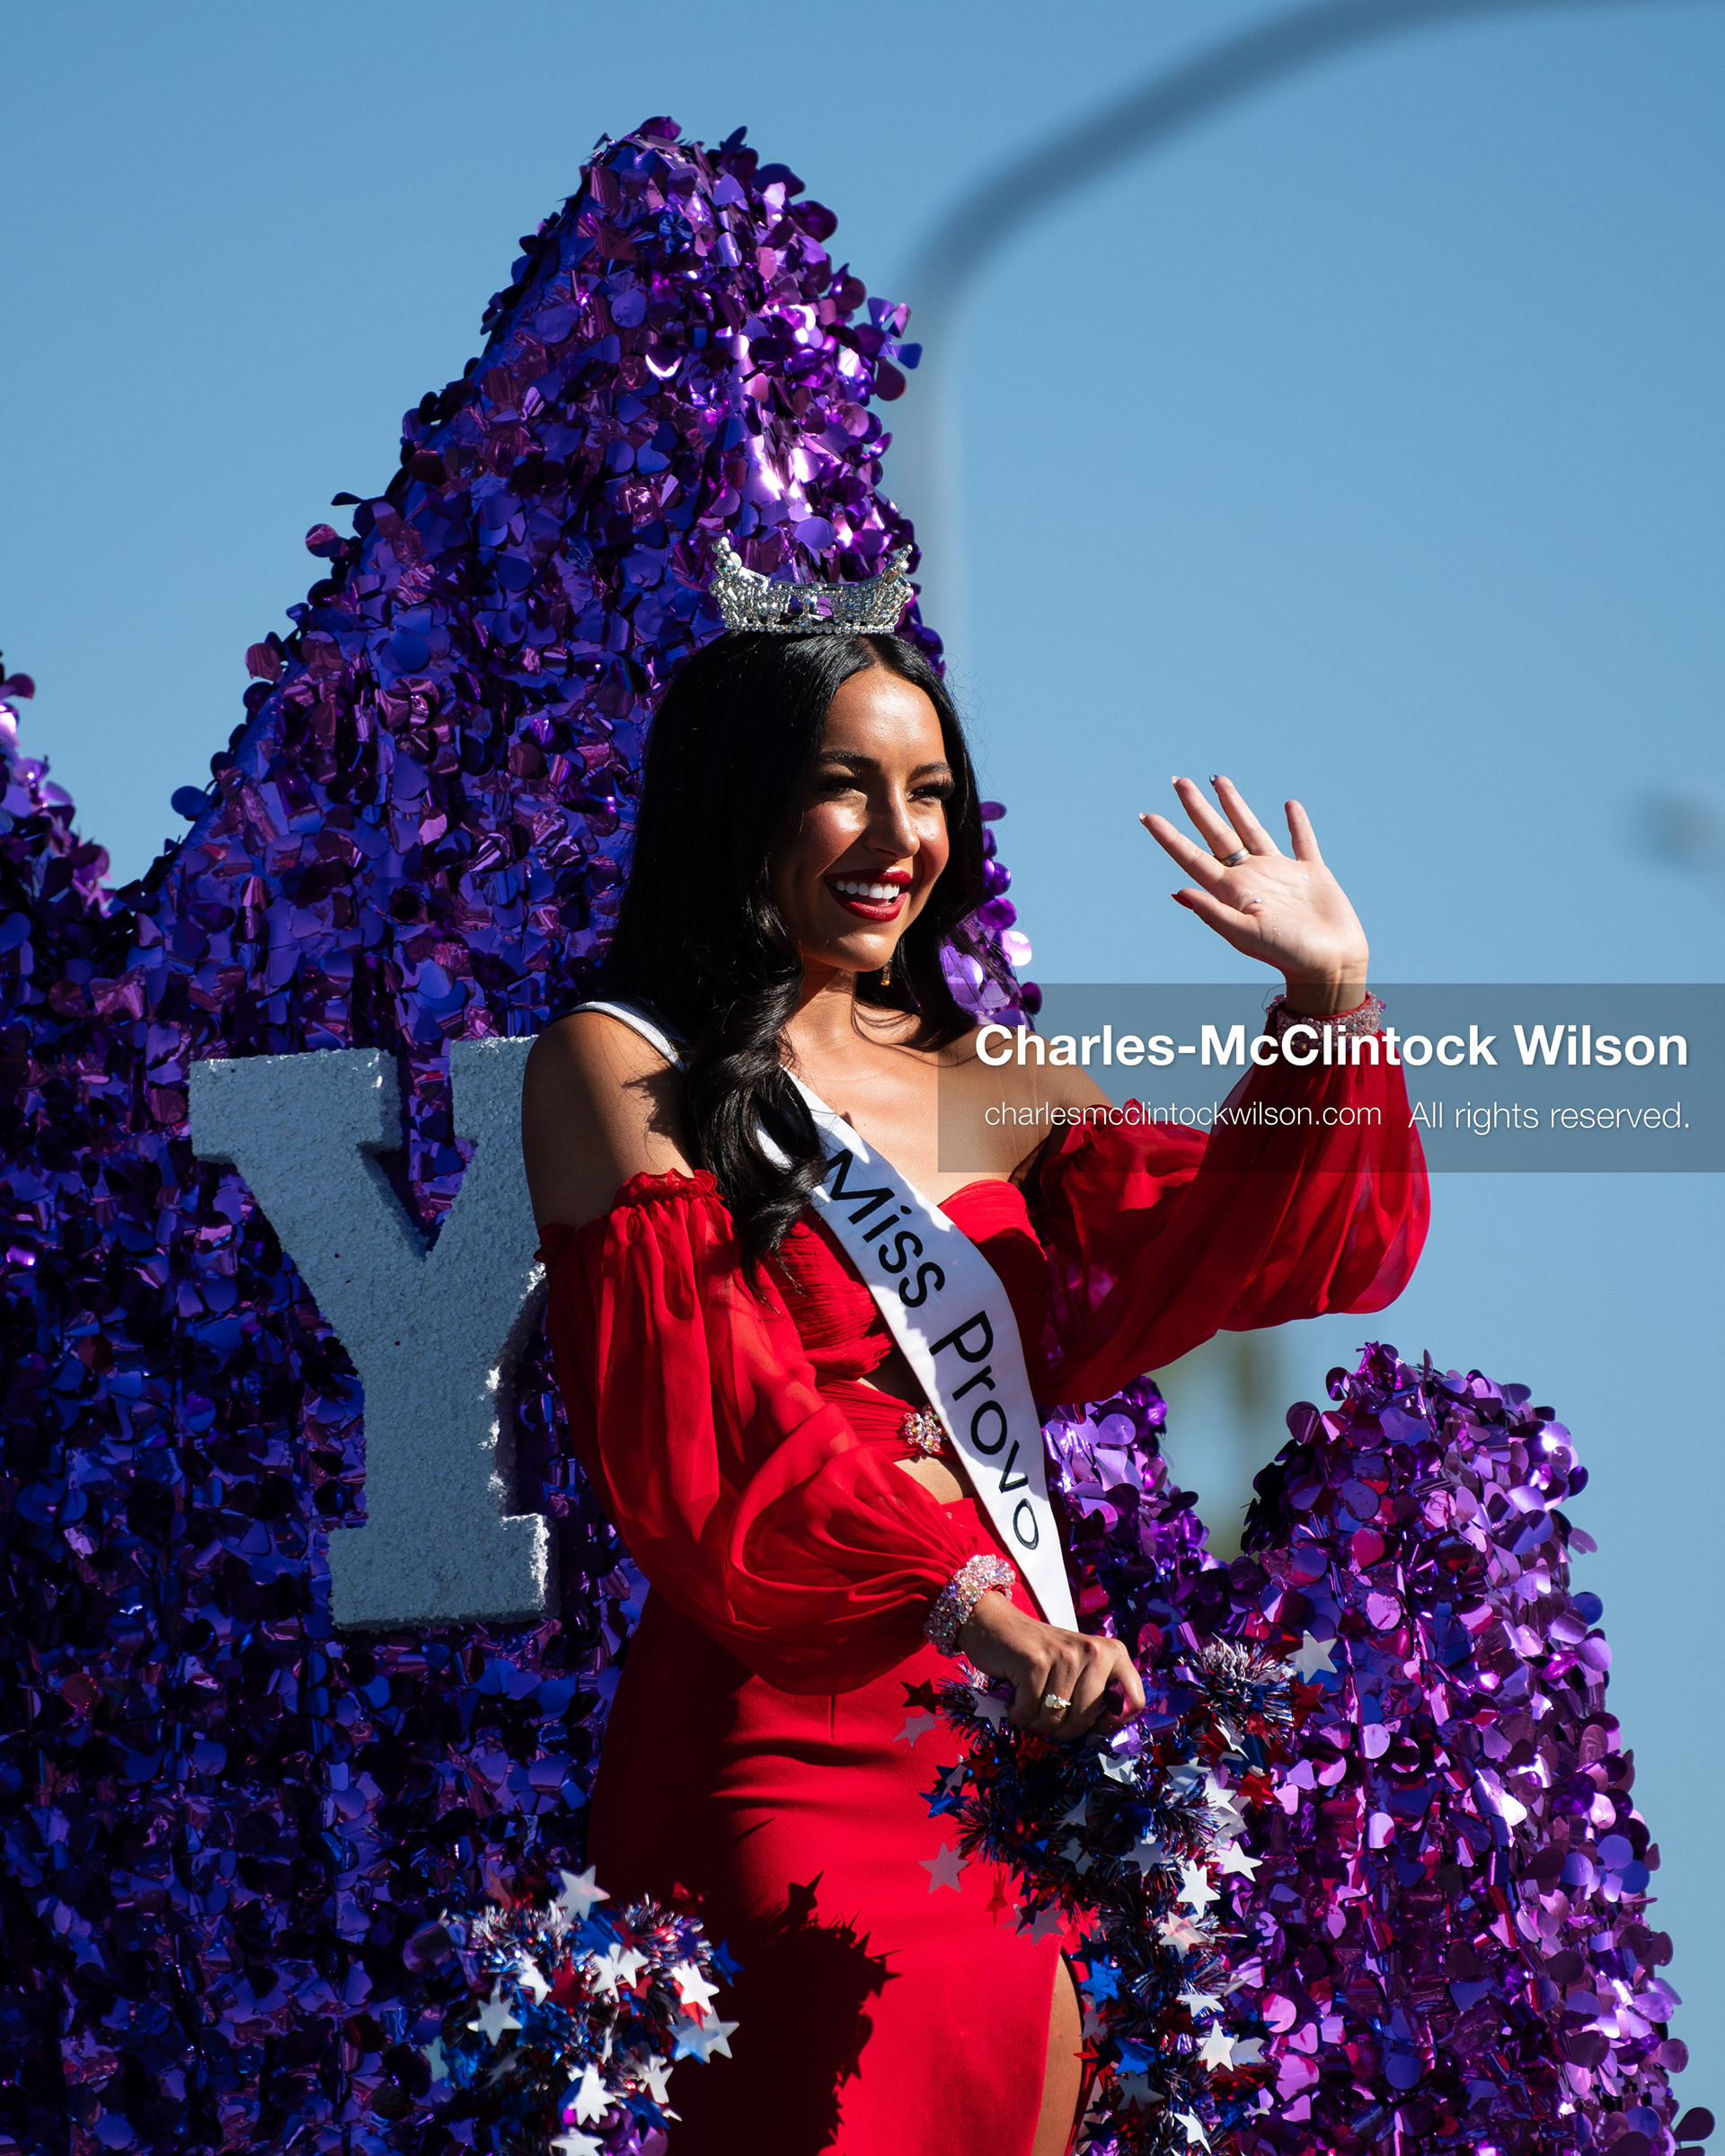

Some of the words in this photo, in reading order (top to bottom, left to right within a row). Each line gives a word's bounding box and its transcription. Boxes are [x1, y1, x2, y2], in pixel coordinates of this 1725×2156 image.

[188, 1034, 551, 1630] Y
[826, 1148, 946, 1309] Miss
[928, 1310, 1040, 1551] Provo
